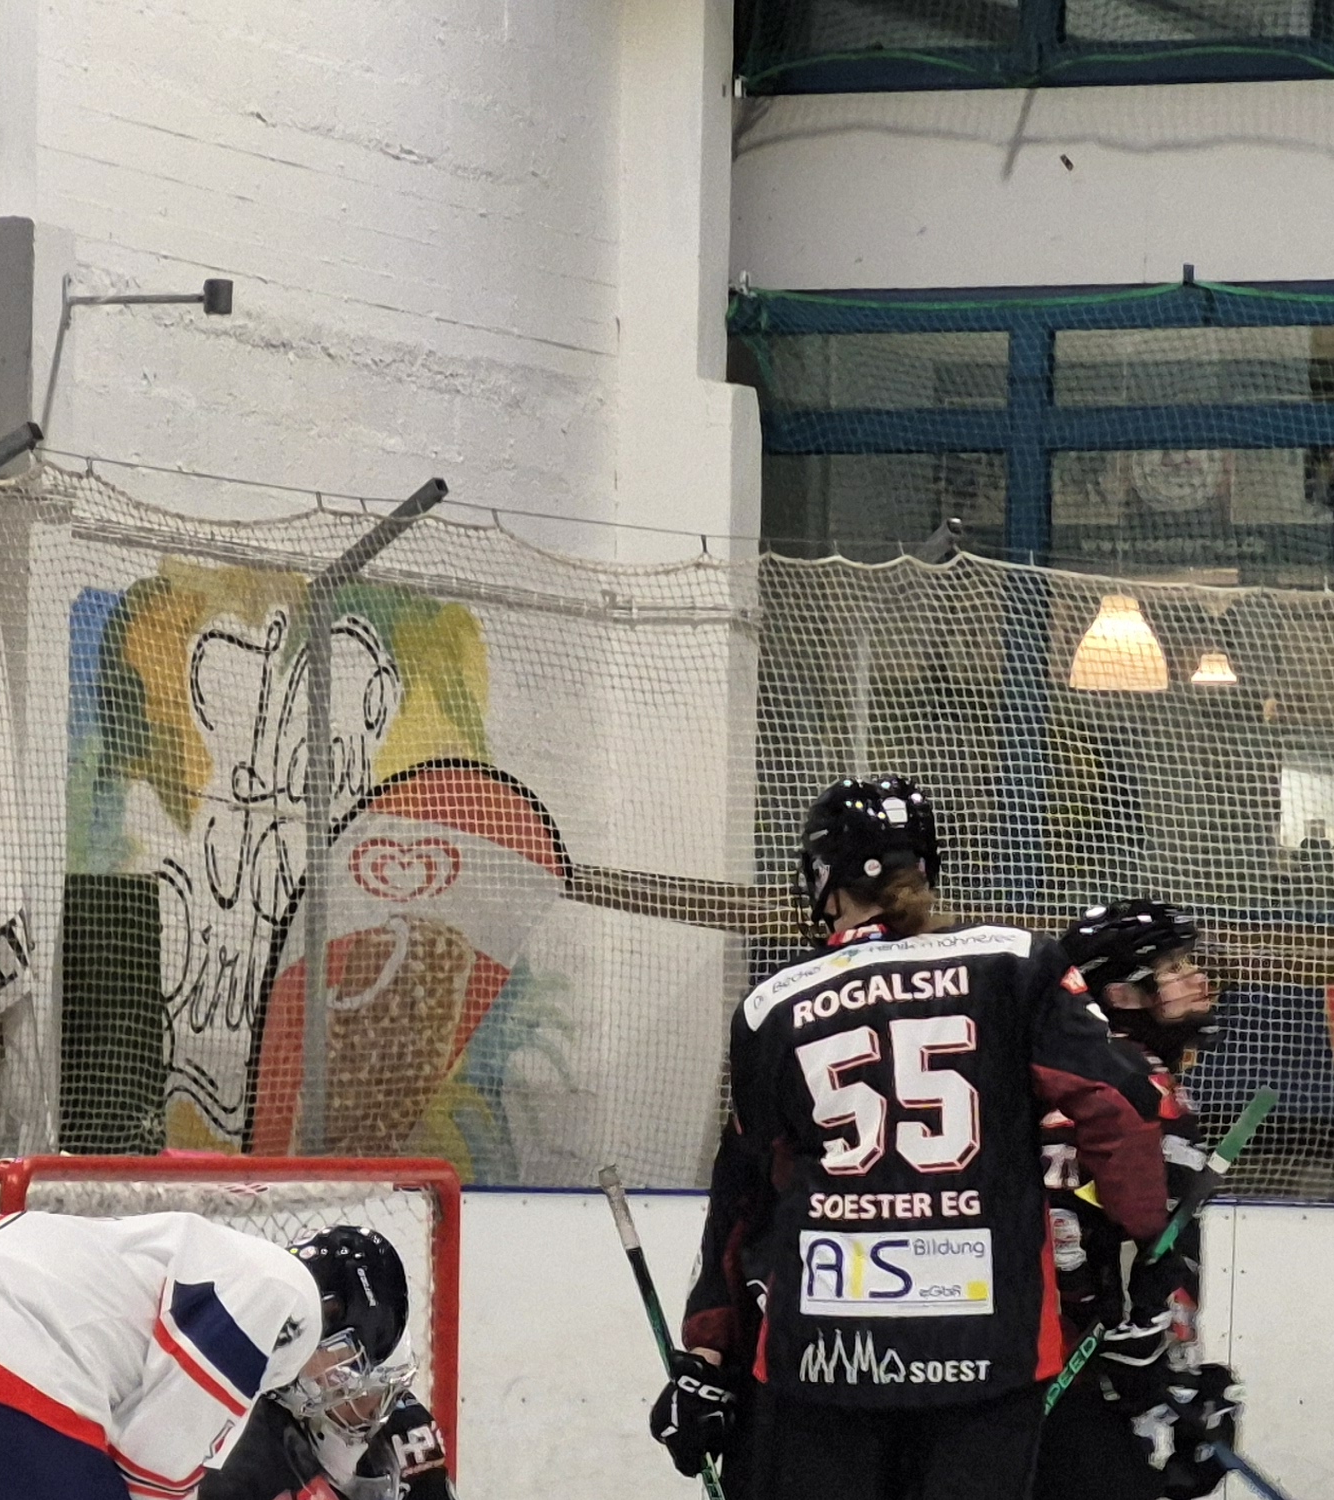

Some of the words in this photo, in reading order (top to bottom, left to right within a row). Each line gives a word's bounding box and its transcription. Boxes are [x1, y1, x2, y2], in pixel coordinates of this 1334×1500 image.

[792, 965, 969, 1028] ROGALSKI
[795, 1015, 980, 1175] 55
[808, 1192, 933, 1219] SOESTER
[941, 1190, 981, 1216] EG
[914, 1238, 985, 1258] Bildung
[909, 1359, 991, 1383] SOEST
